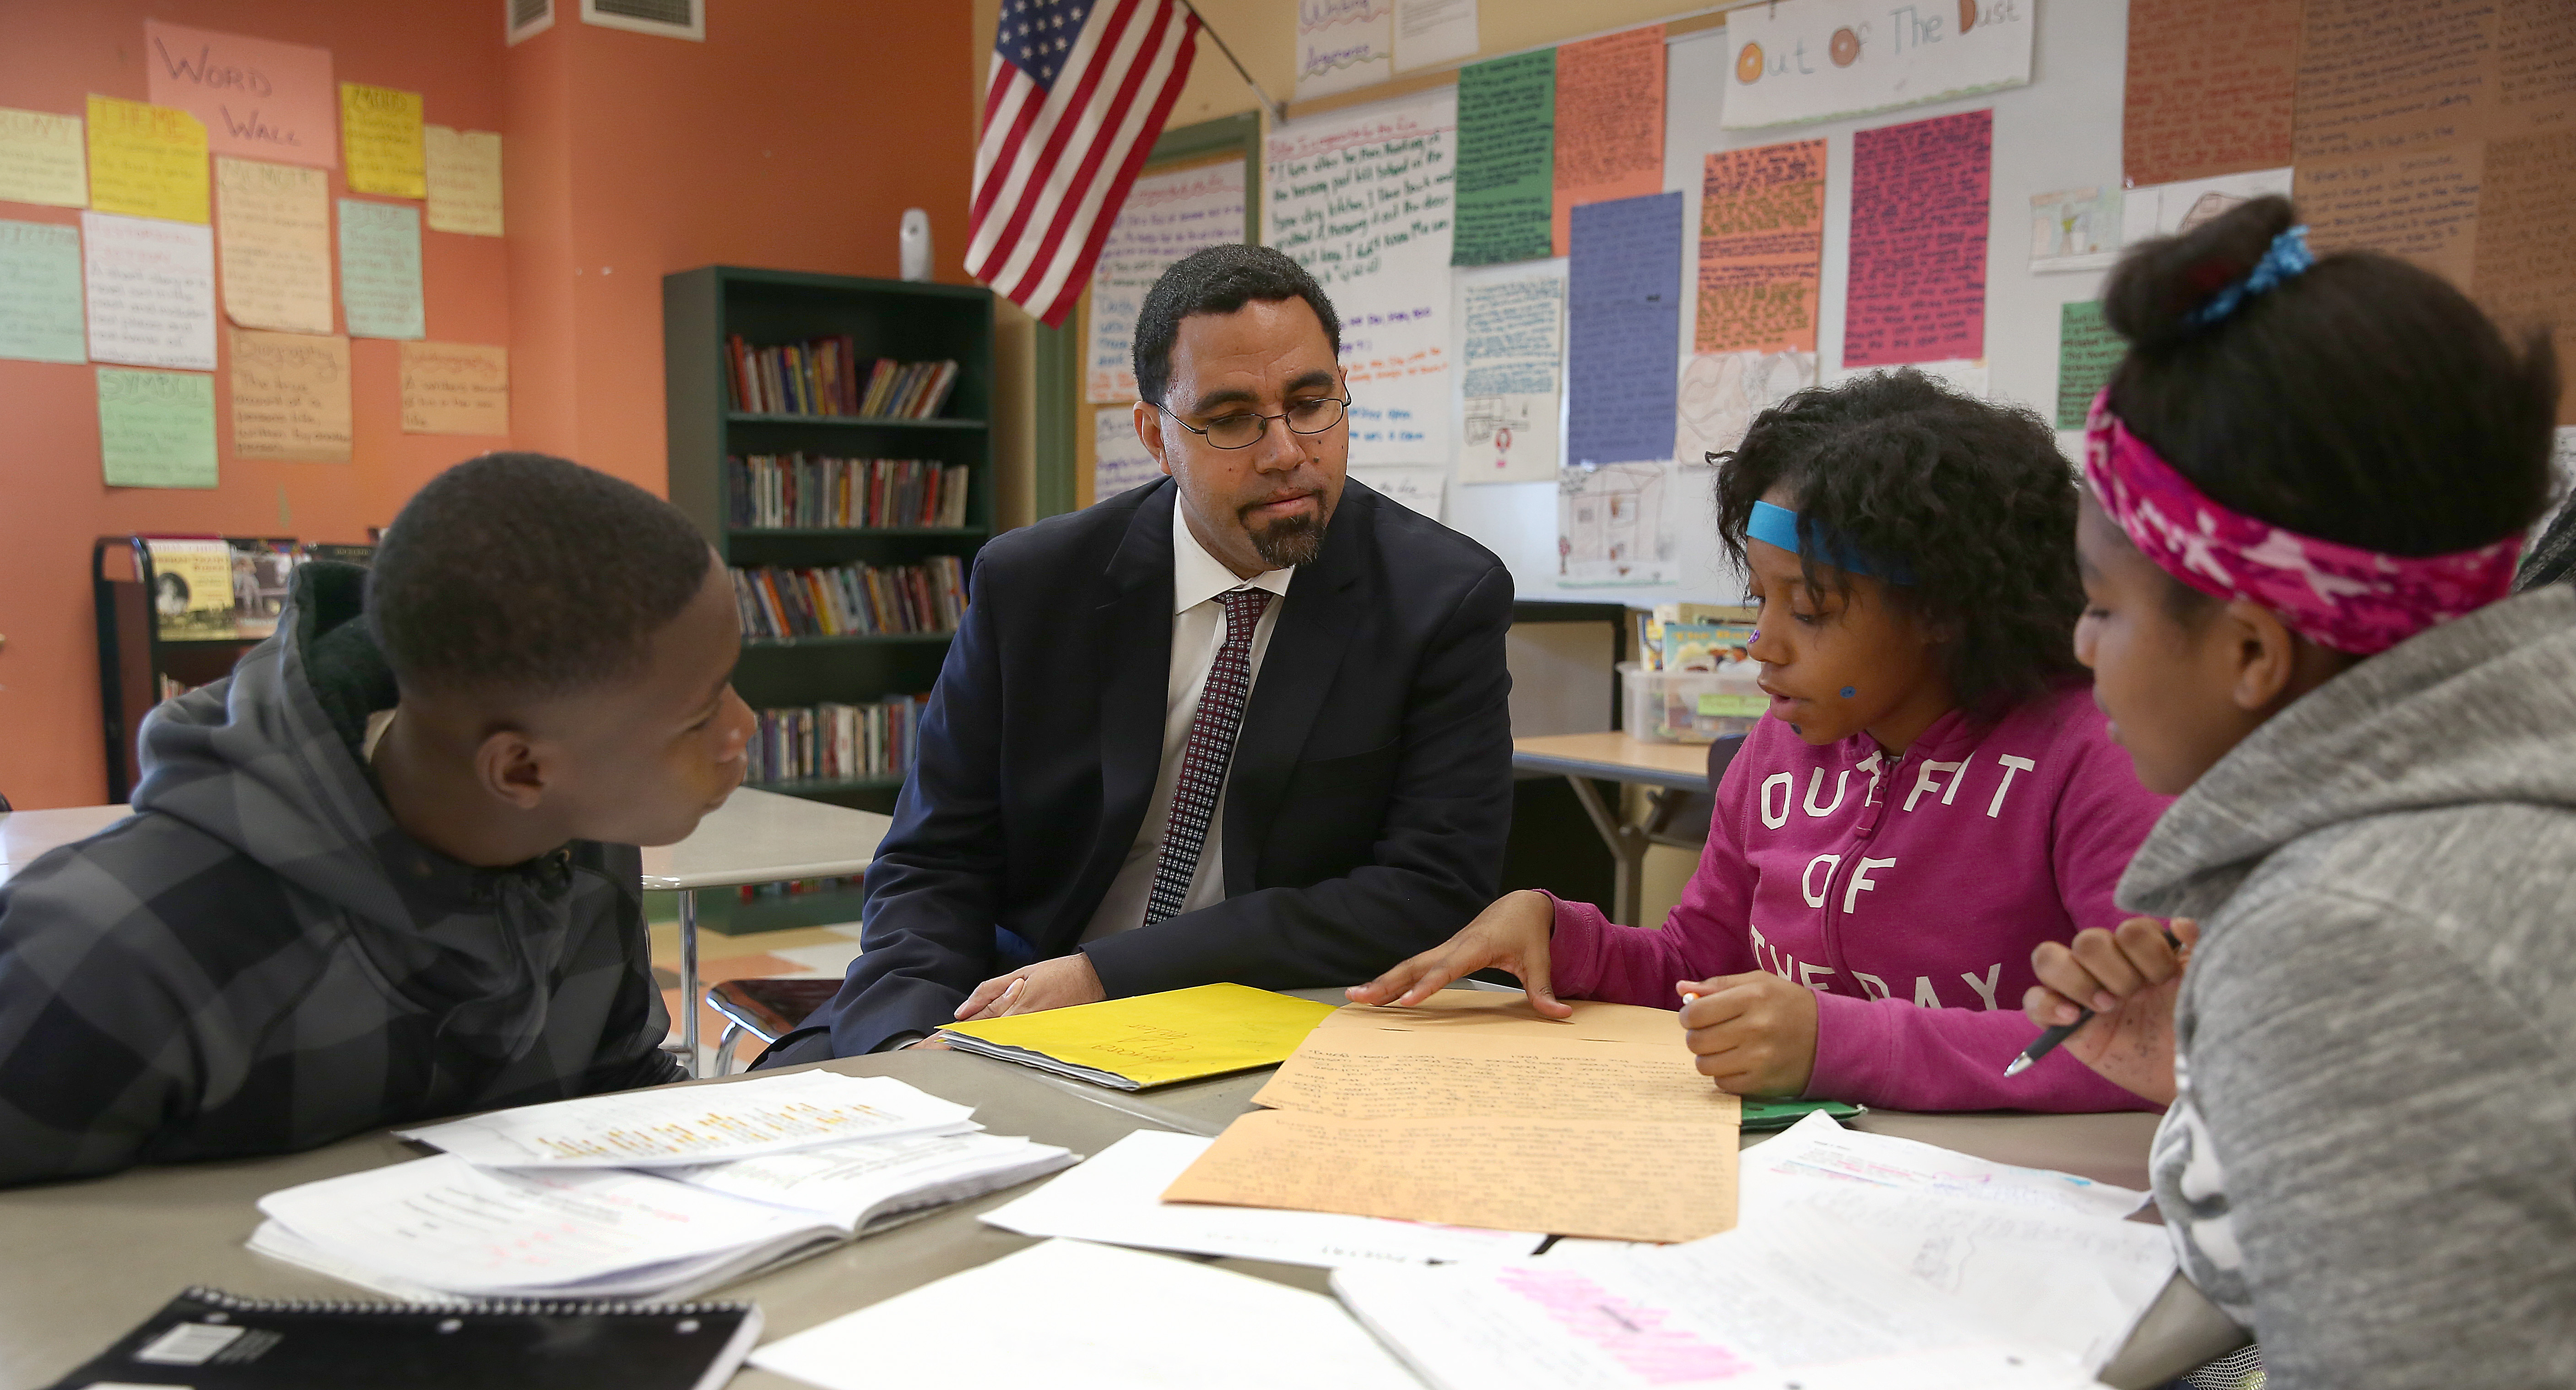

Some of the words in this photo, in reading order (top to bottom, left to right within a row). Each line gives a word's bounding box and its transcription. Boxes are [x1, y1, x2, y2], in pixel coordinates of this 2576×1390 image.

[154, 36, 273, 98] WORD
[1735, 39, 1815, 84] Out
[1829, 21, 1873, 68] Of
[1889, 4, 1944, 56] The
[1957, 0, 2022, 35] Dust
[94, 102, 188, 139] THEME
[220, 103, 302, 147] WALL
[100, 373, 200, 400] SYMBOL
[1760, 749, 2036, 830] OUTFIT
[1802, 854, 1897, 914] OF
